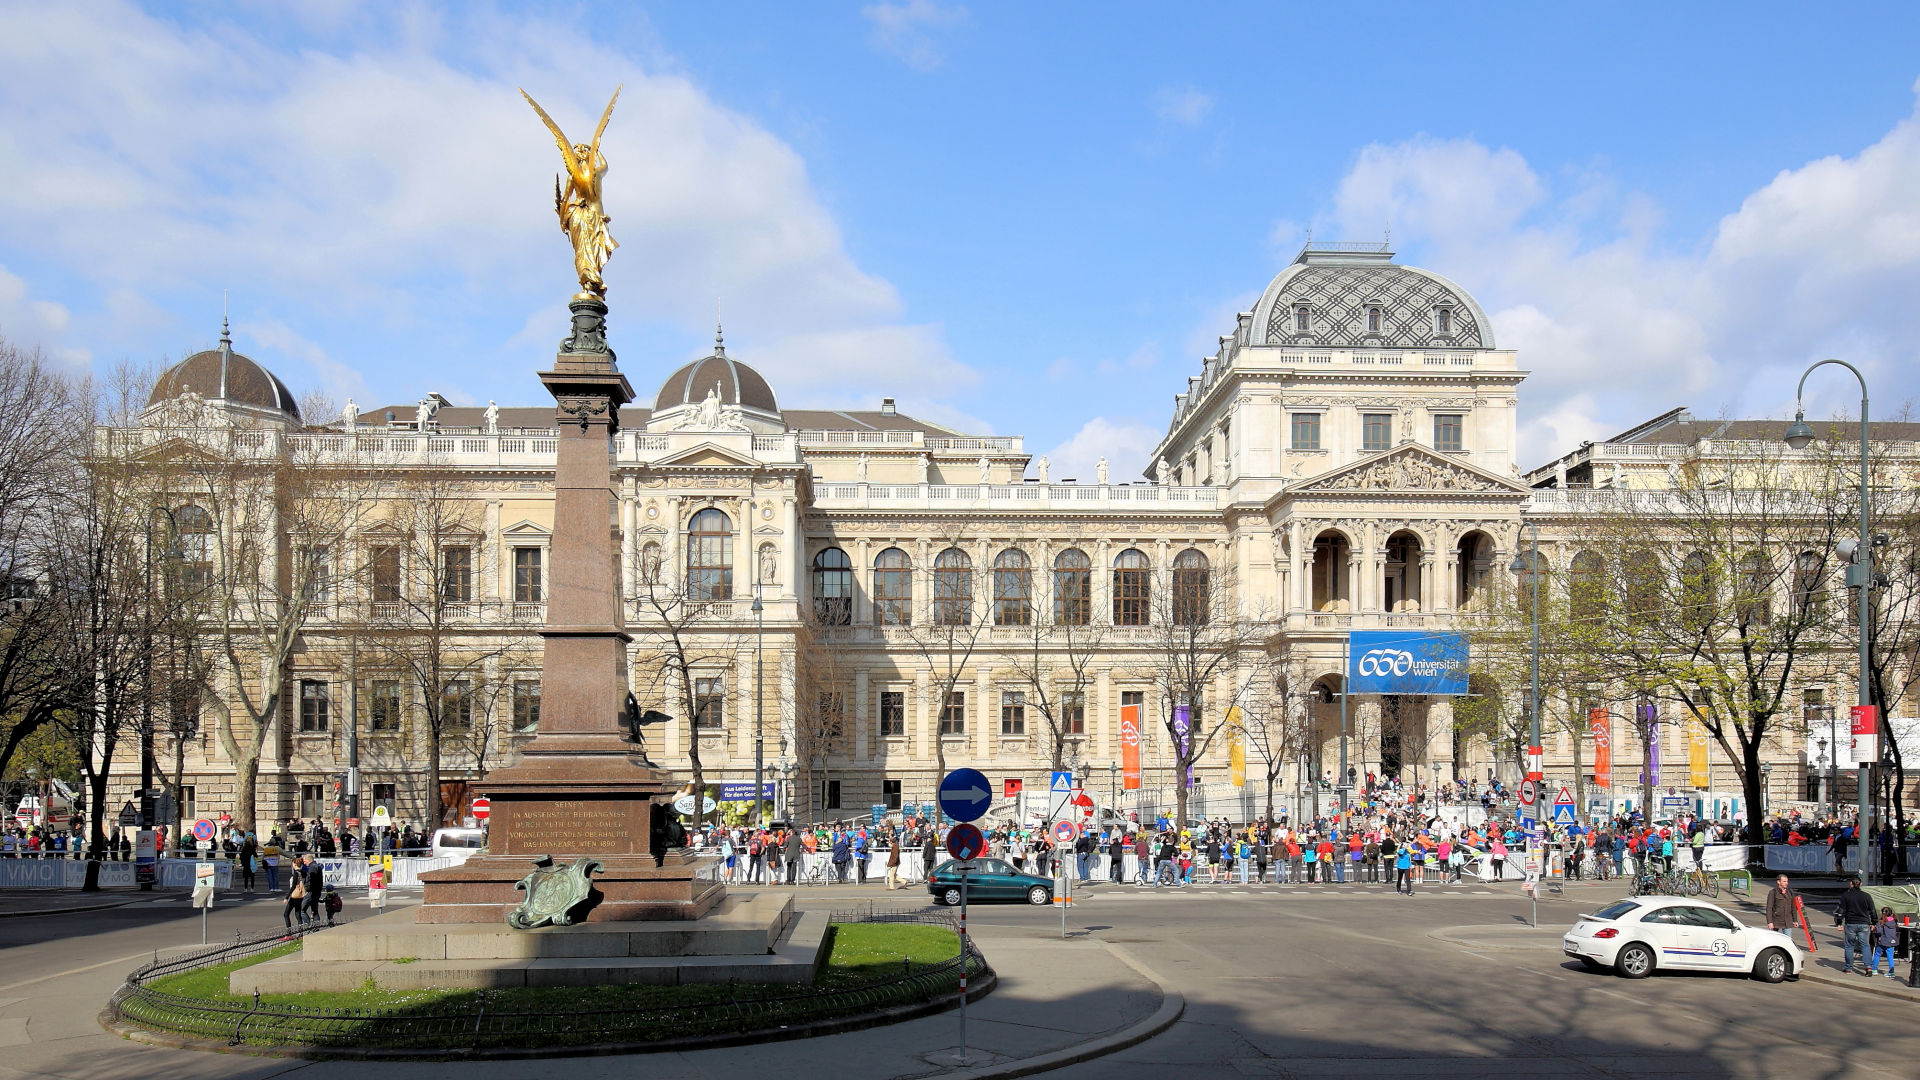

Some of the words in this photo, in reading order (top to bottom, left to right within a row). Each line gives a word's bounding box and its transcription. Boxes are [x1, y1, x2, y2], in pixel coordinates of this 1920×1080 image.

[1358, 648, 1414, 677] 650
[1412, 659, 1460, 670] universität
[1412, 667, 1438, 677] wien
[515, 821, 541, 829] DURCH
[579, 840, 597, 848] WIEN
[600, 840, 616, 848] 1890
[1713, 942, 1727, 953] 53
